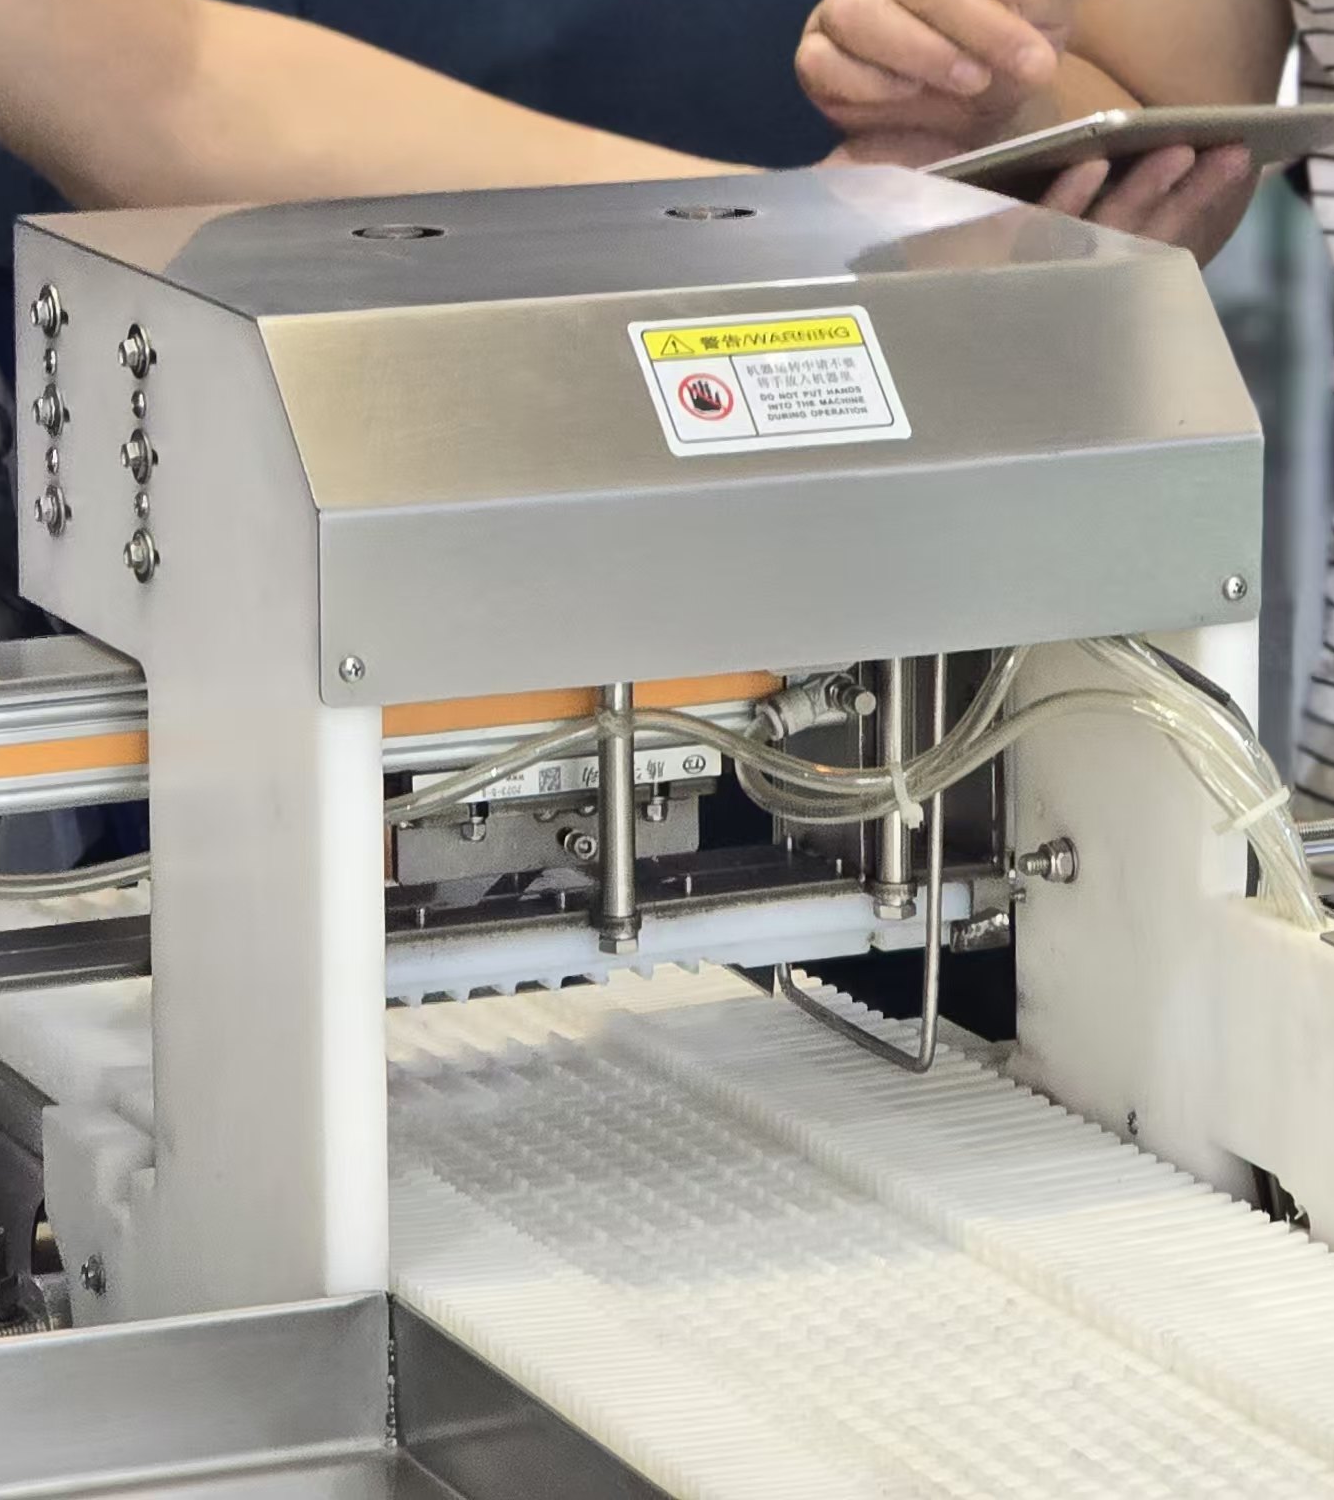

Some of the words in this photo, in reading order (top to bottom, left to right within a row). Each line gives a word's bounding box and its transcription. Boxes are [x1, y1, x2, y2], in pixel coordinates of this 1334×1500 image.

[746, 357, 856, 377] 机器运转中请不要
[759, 393, 775, 401] DO
[779, 391, 798, 400] NOT
[803, 389, 822, 398] PUT
[827, 386, 862, 395] HANDS
[768, 401, 792, 410] INTO
[796, 400, 816, 408] THE
[819, 396, 865, 406] MACHINE
[767, 411, 807, 421] DURING
[810, 406, 868, 418] OPERATION
